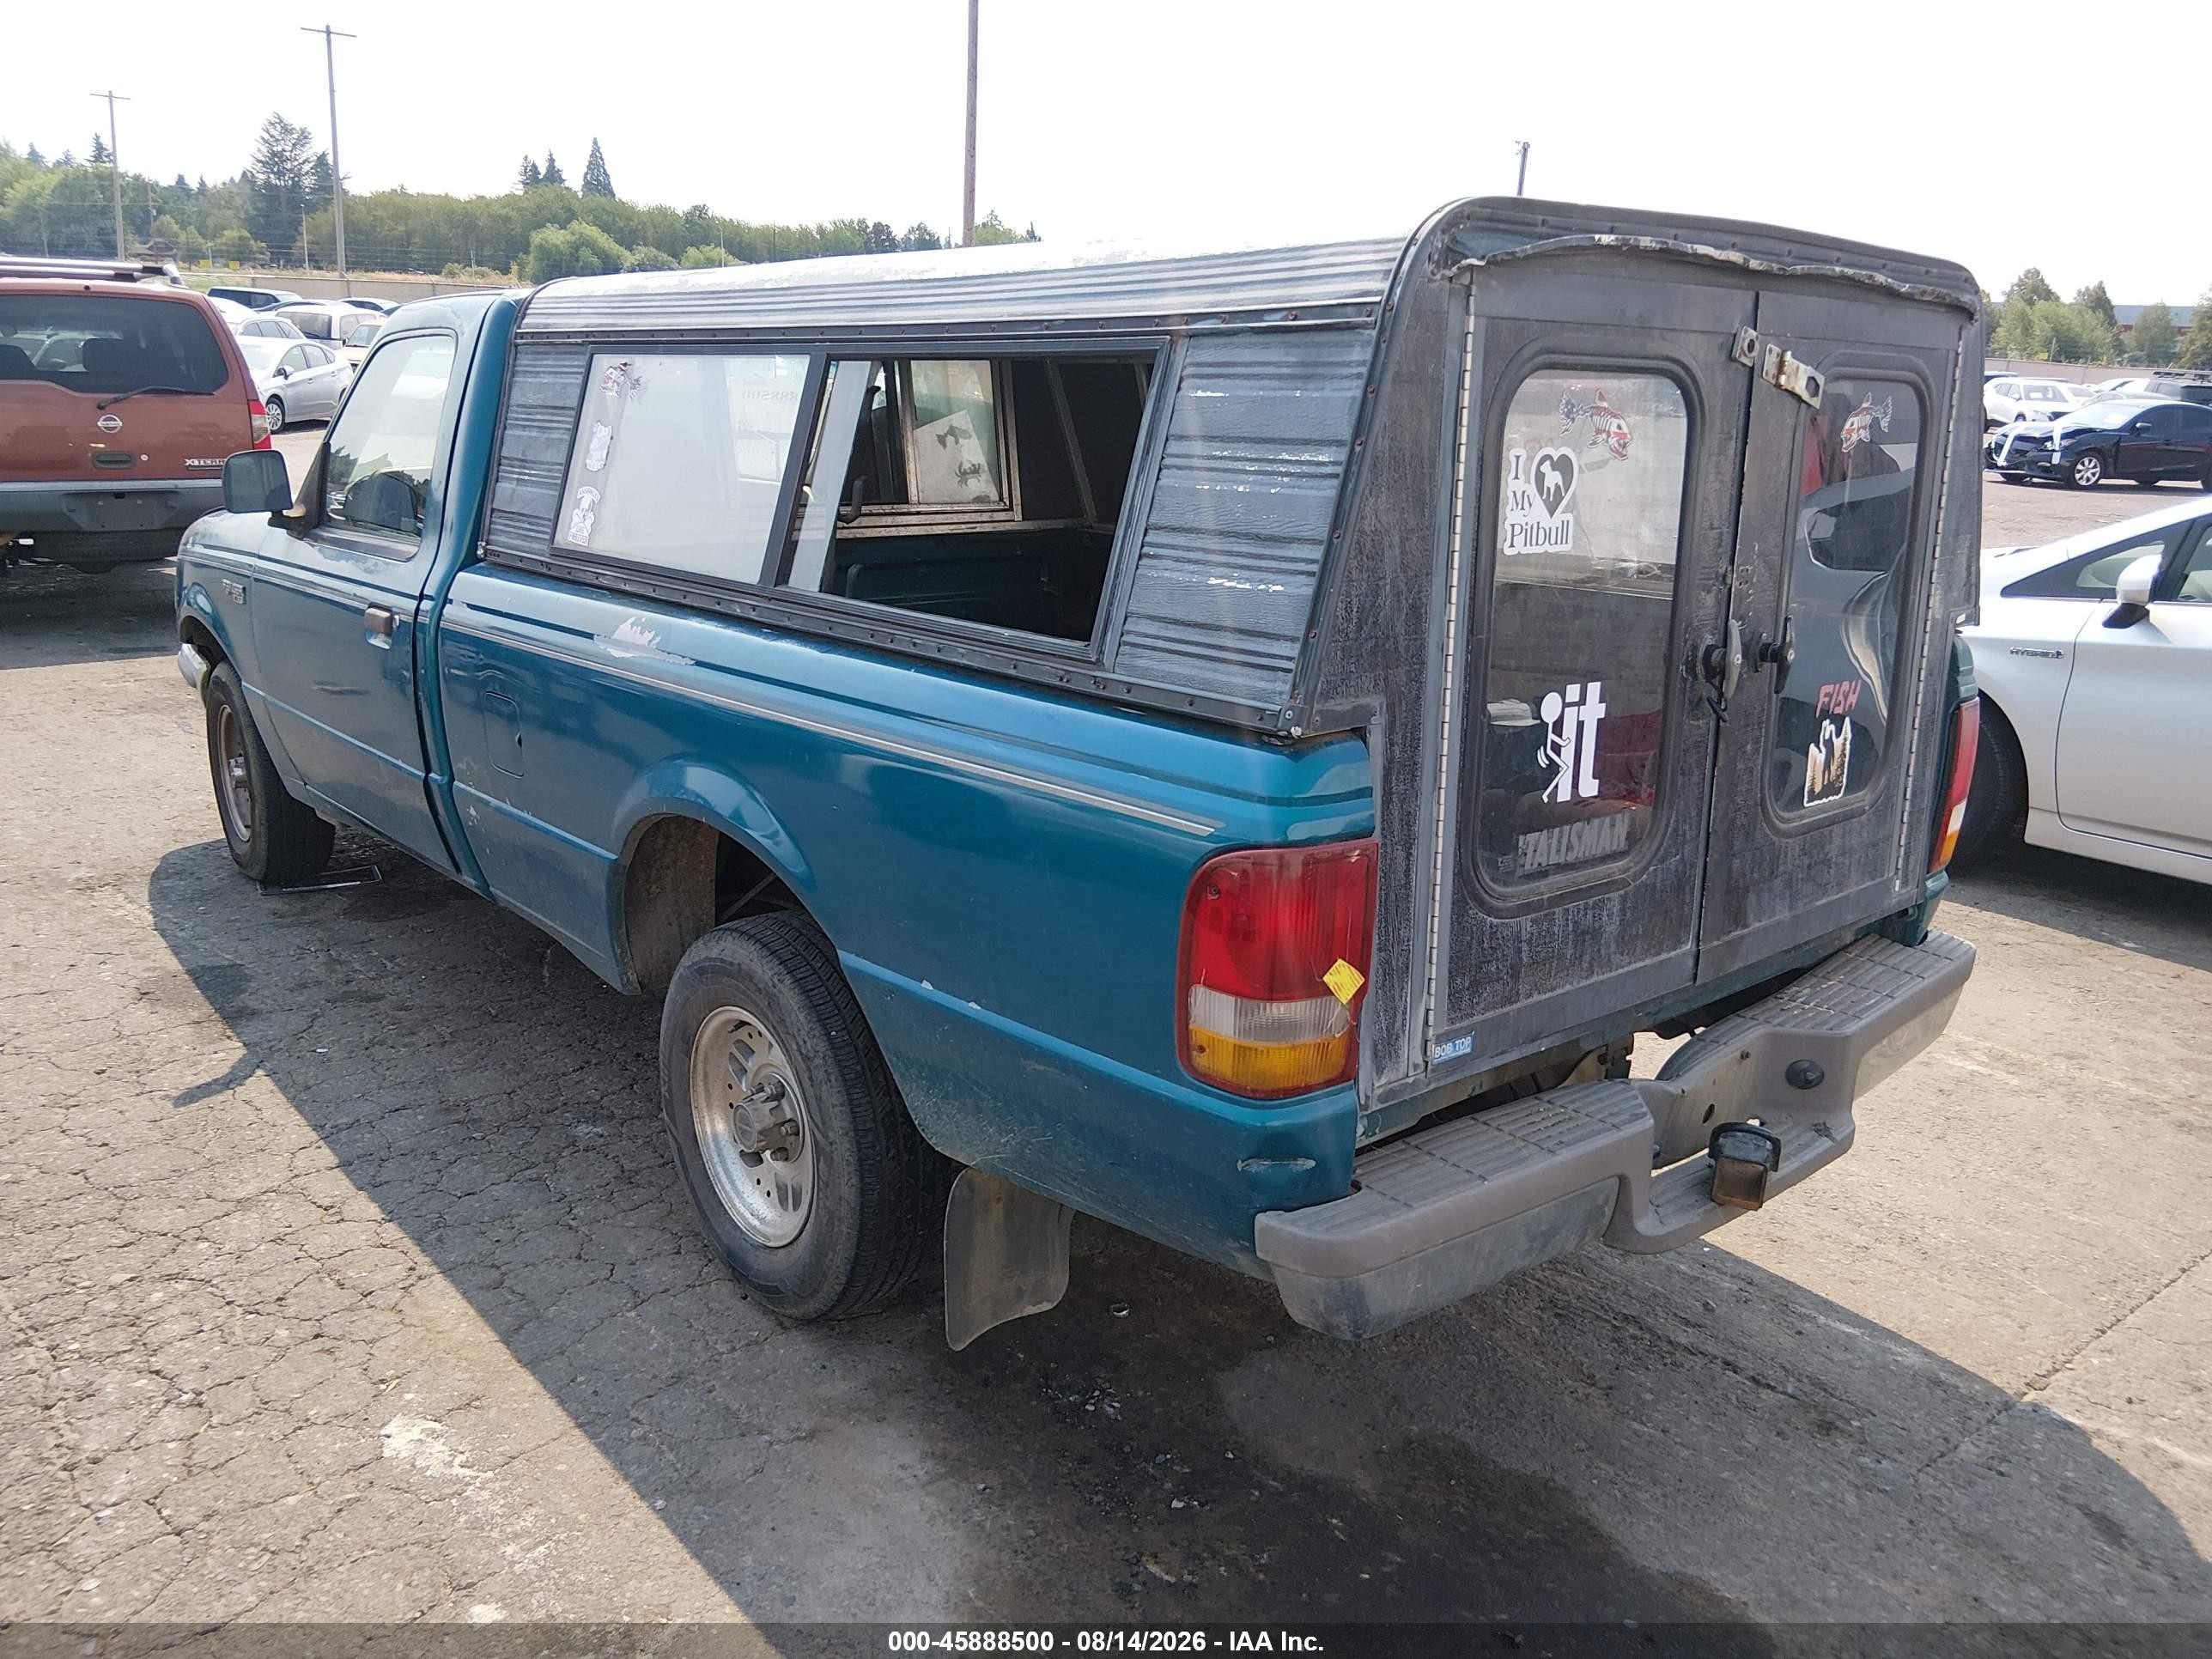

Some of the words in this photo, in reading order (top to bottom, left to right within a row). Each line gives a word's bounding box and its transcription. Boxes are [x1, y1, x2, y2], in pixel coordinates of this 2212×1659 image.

[184, 458, 228, 466] XTERR
[1512, 455, 1522, 480] I
[1510, 490, 1534, 517] My
[1508, 520, 1570, 548] Pitbull
[1815, 680, 1861, 718] FISH
[1556, 681, 1607, 802] it
[1524, 813, 1631, 870] TALISMAN
[1434, 1043, 1453, 1058] BOB
[1455, 1036, 1472, 1051] TOP
